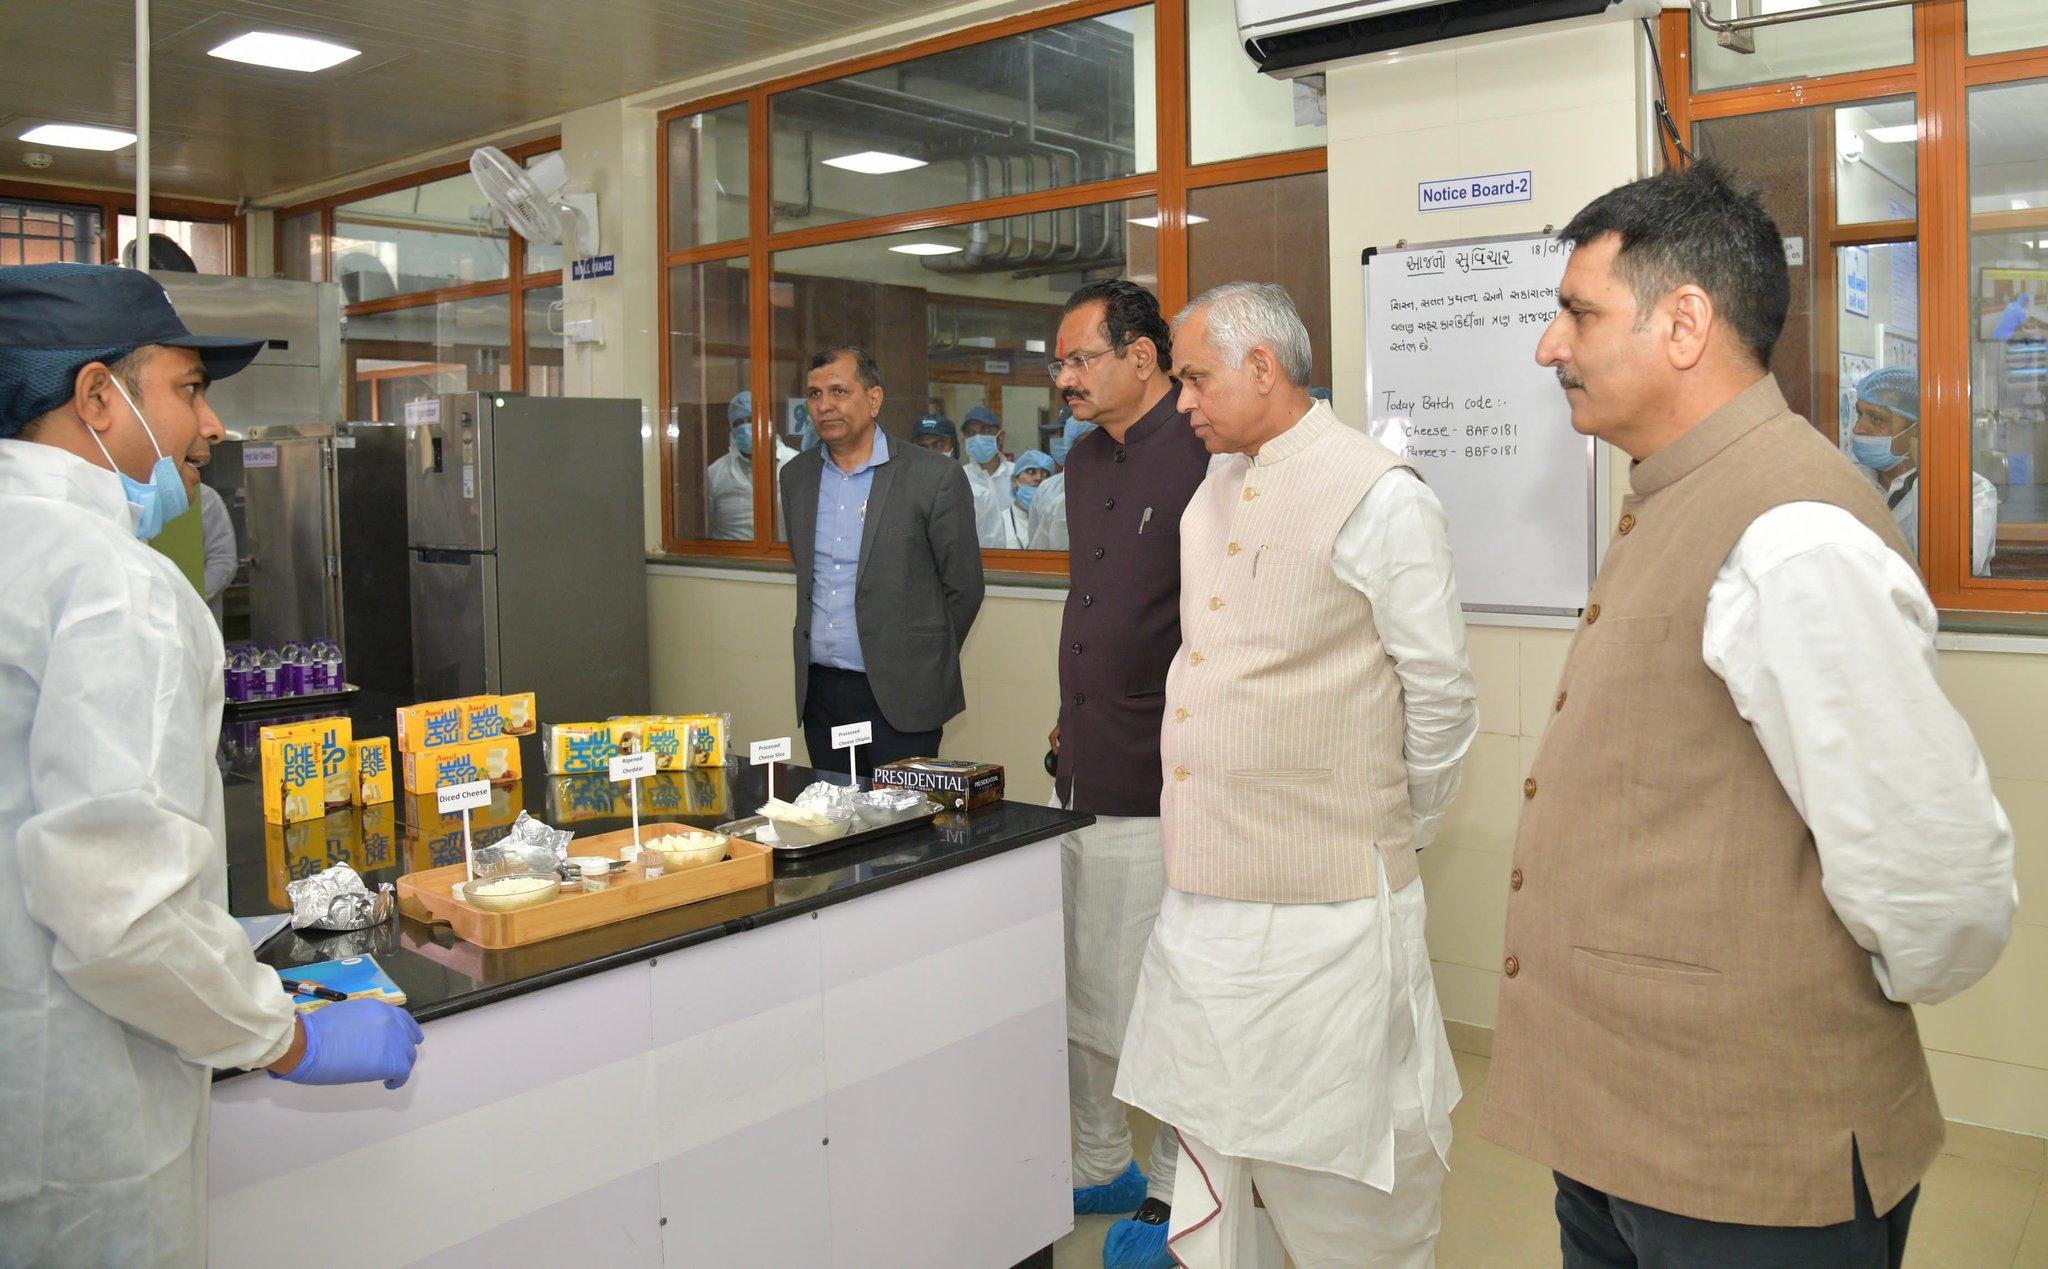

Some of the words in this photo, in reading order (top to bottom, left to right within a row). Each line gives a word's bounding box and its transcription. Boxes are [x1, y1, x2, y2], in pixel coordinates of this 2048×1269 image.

[1423, 187, 1467, 203] Notice
[1472, 178, 1528, 198] Board-2
[1531, 240, 1574, 258] 18/01/2
[1406, 251, 1446, 271] આજનો
[1455, 248, 1513, 273] સુવિચાર
[1382, 390, 1416, 418] Today
[1421, 395, 1454, 410] Batch
[1465, 423, 1518, 437] BAF0181
[1465, 445, 1518, 458] BBF0181
[622, 756, 643, 764] Ripened
[622, 766, 644, 774] Cheddar
[874, 768, 965, 792] PRESIDENTIAL
[439, 792, 461, 803] Diced
[461, 789, 488, 799] Cheese
